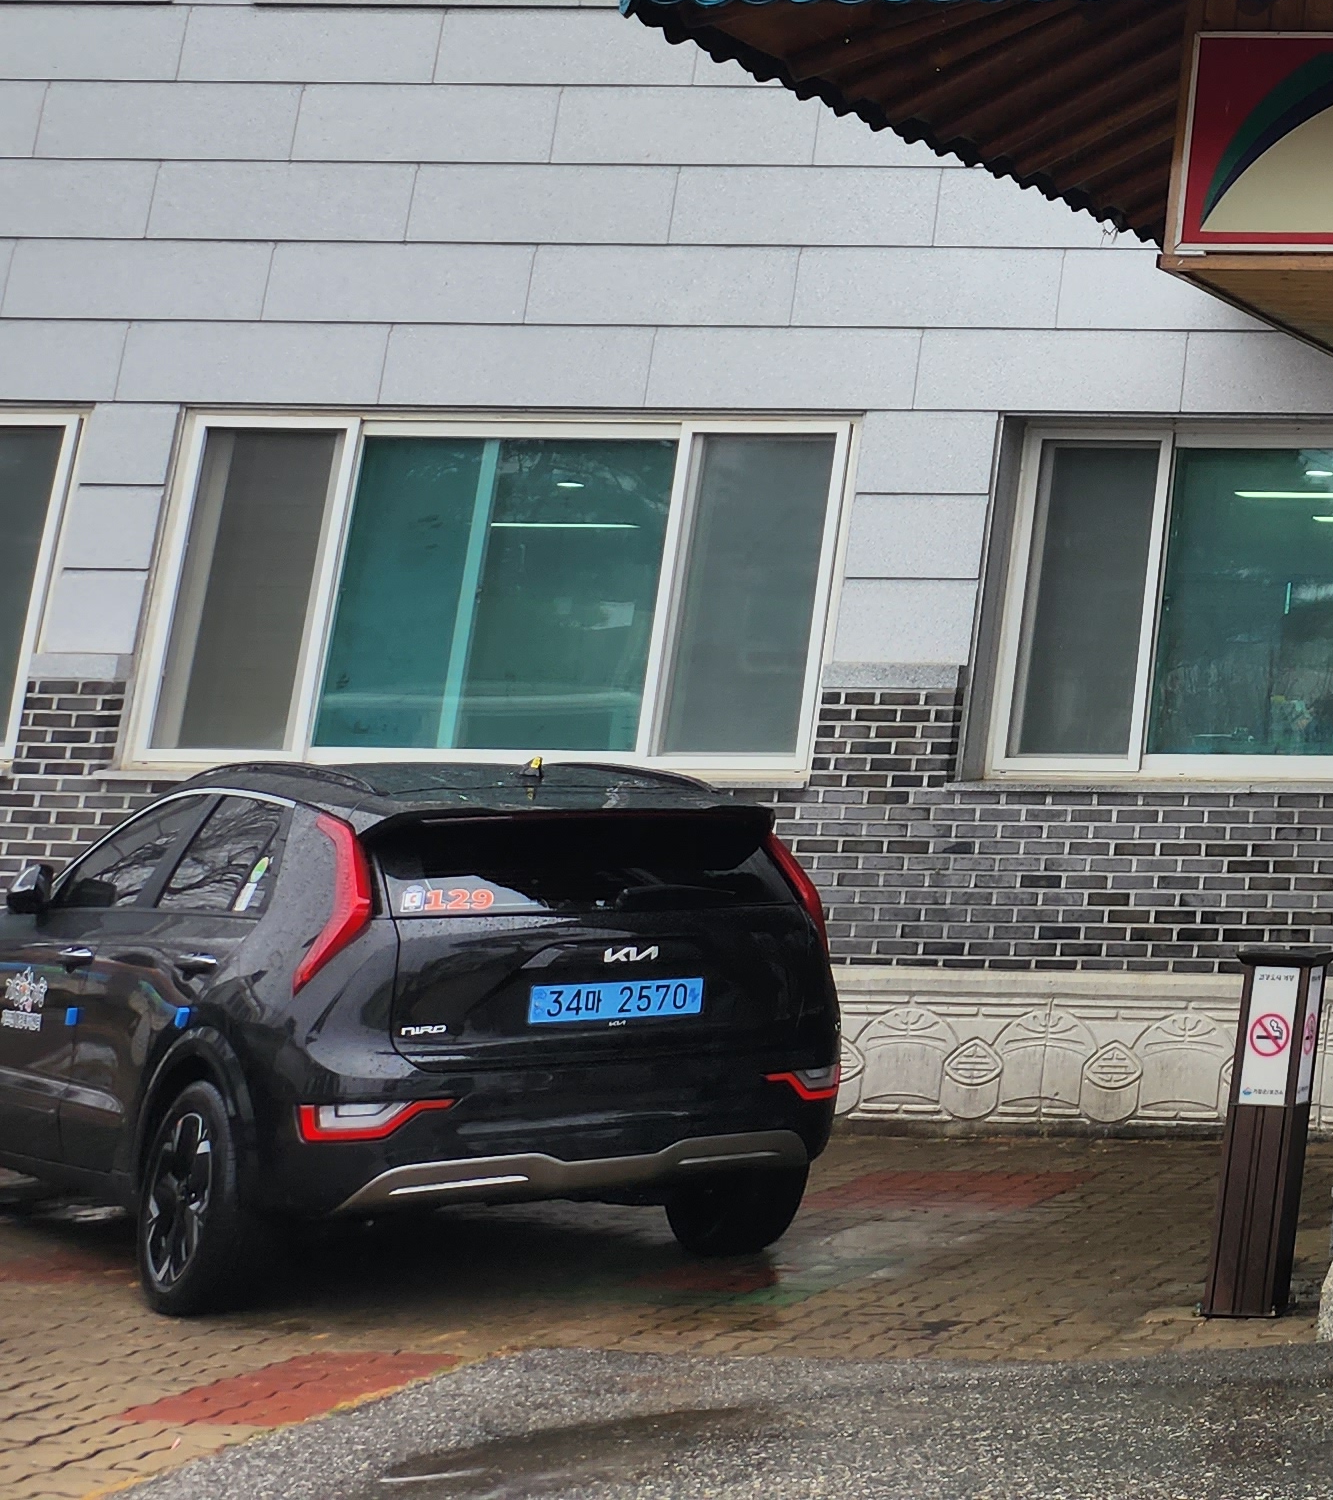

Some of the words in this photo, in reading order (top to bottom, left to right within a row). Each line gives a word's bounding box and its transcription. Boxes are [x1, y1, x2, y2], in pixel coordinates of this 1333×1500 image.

[425, 888, 494, 910] 129
[604, 945, 659, 963] KIA
[546, 988, 602, 1017] 34마
[618, 983, 689, 1014] 2570
[401, 1024, 447, 1036] NIRO
